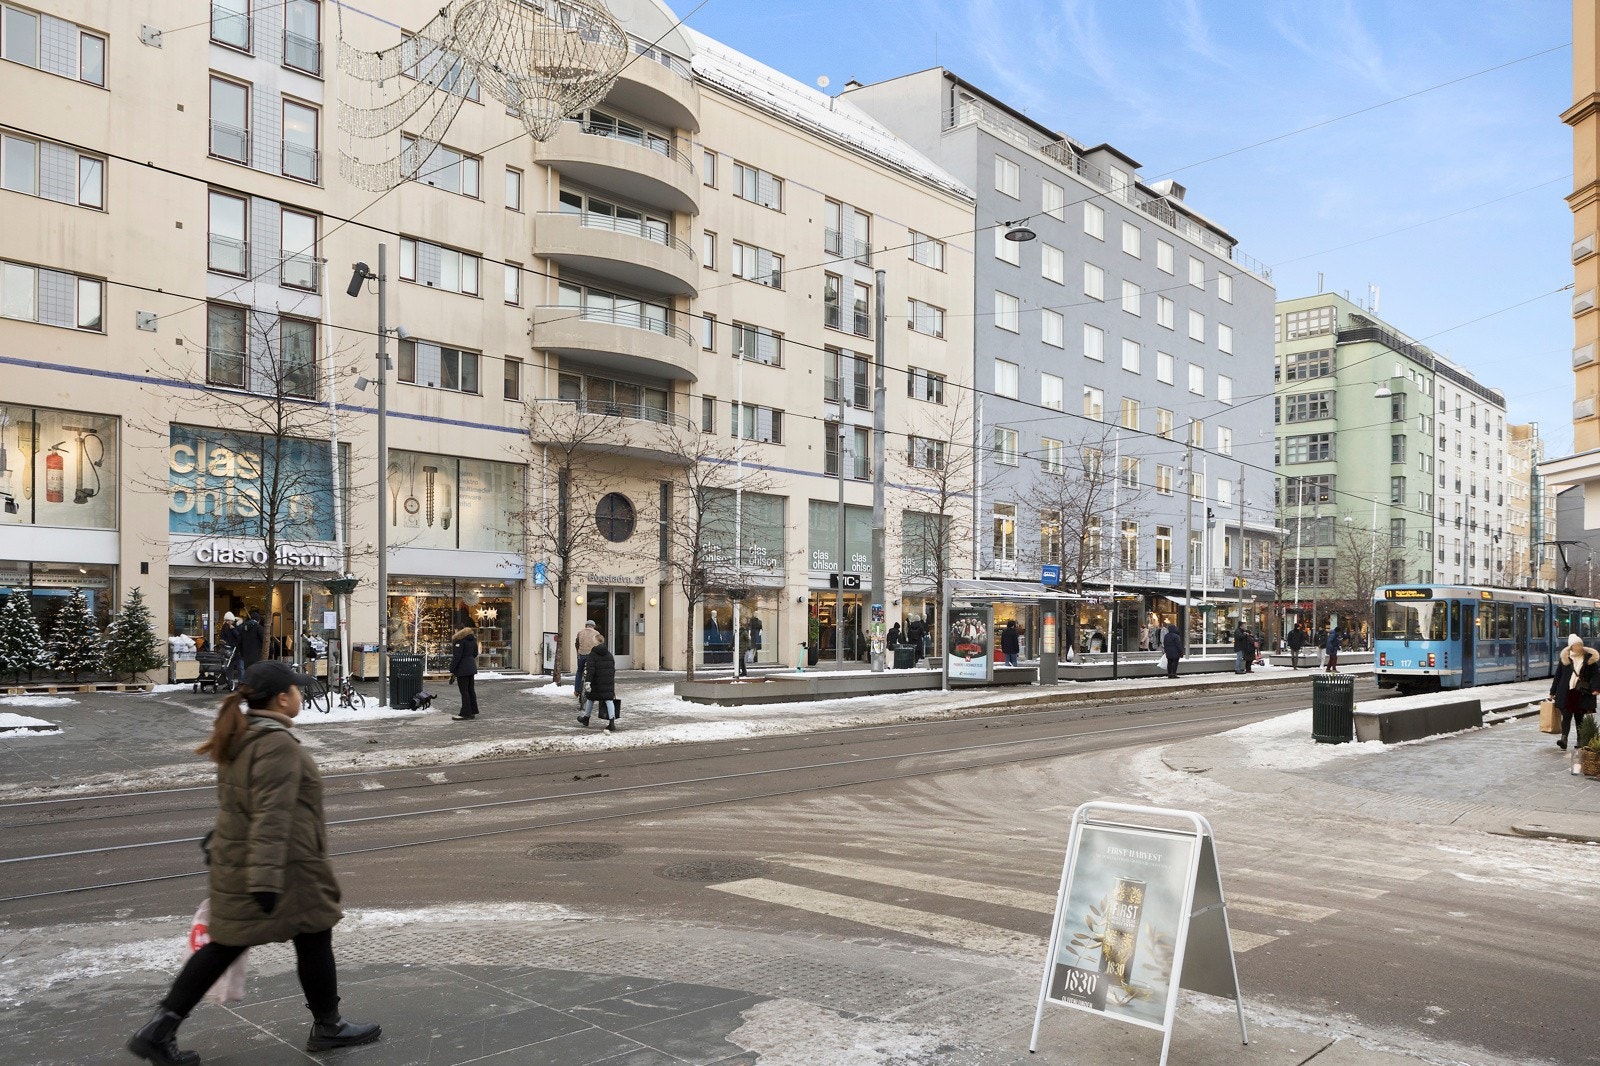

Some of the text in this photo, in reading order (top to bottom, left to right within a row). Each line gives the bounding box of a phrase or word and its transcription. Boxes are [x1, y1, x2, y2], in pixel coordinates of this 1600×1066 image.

[170, 437, 261, 479] clas
[169, 475, 314, 522] ohlsn
[702, 541, 722, 552] clas
[748, 545, 767, 556] clas
[196, 542, 247, 564] clas
[812, 550, 829, 560] clas
[851, 553, 867, 563] clas
[748, 556, 777, 567] ohlson
[812, 560, 838, 571] ohlson
[851, 562, 873, 572] ohlso
[1386, 590, 1392, 598] 11
[1107, 846, 1128, 858] FIRST
[1128, 849, 1163, 862] HARVEST
[1106, 960, 1125, 976] 1830
[1064, 968, 1097, 995] 1830
